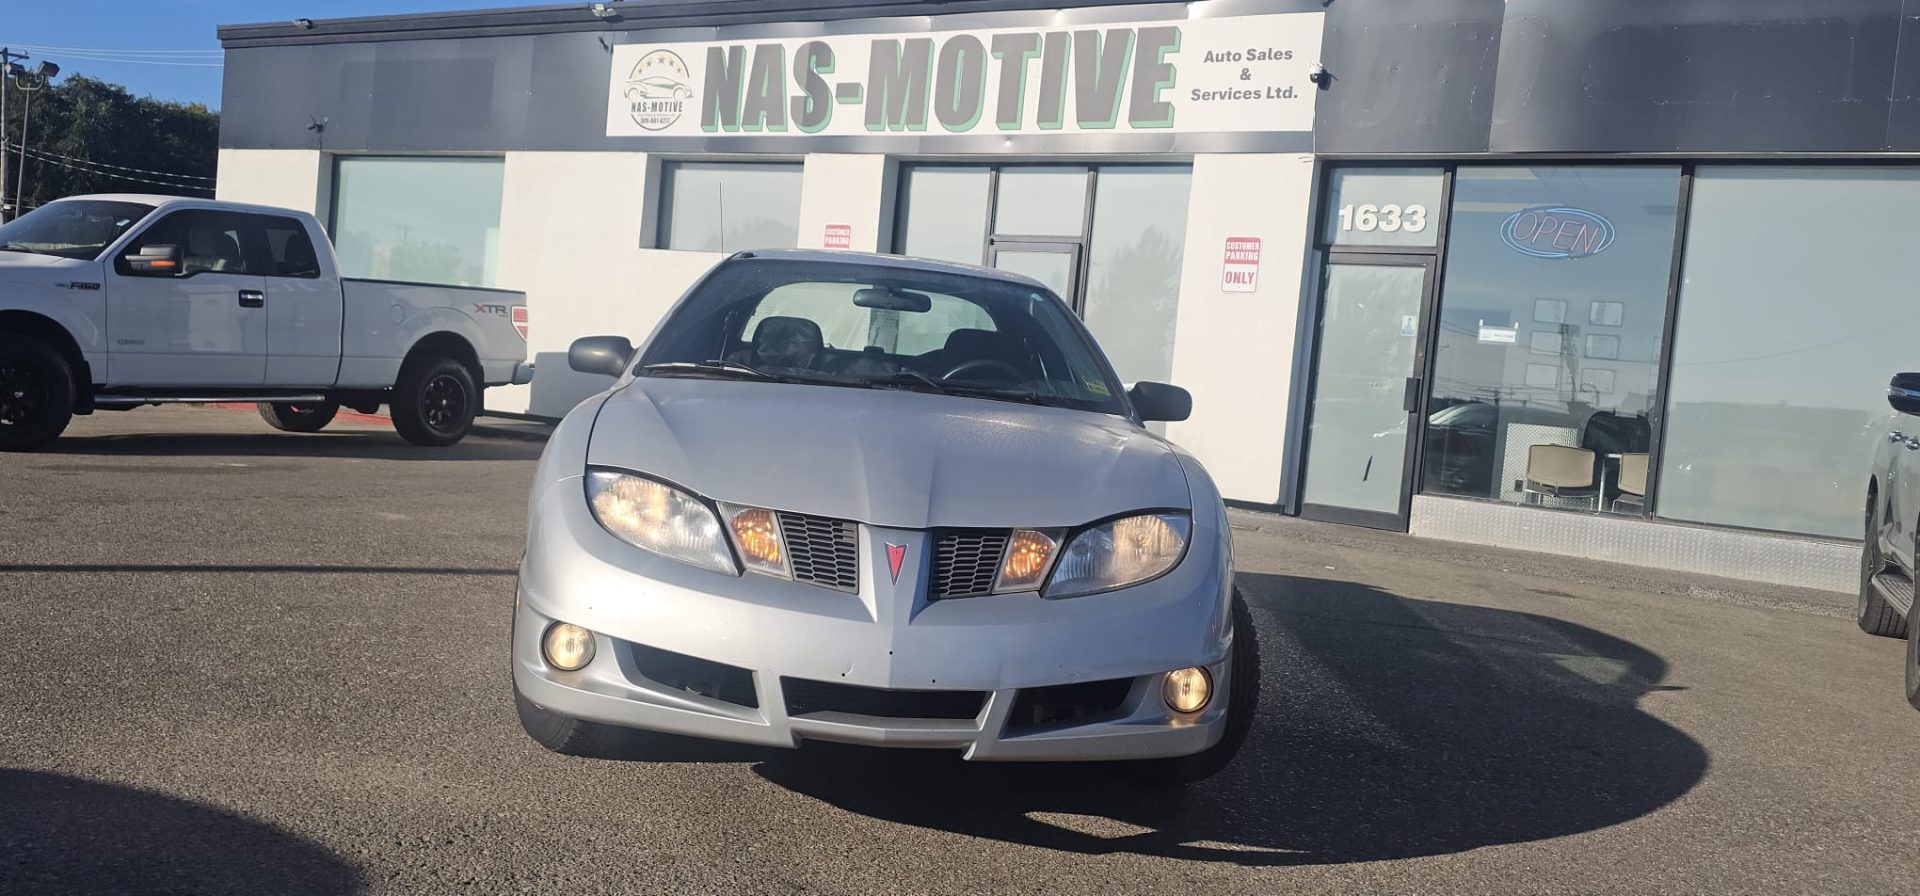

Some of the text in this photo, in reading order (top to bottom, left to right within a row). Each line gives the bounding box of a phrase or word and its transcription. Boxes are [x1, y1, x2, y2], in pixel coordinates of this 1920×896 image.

[1204, 48, 1293, 63] Auto Sales
[700, 26, 1182, 134] NAS-MOTIVE
[1240, 68, 1251, 81] &
[1191, 86, 1298, 101] Services Ltd.
[631, 101, 682, 113] NAS-MOTIVE
[1339, 203, 1427, 233] 1633
[1514, 212, 1599, 254] OPEN
[824, 236, 849, 245] PARKING
[1226, 241, 1259, 250] CUSTOMER
[1225, 251, 1259, 261] PARKING
[1225, 271, 1255, 284] ONLY
[474, 304, 507, 314] XTR
